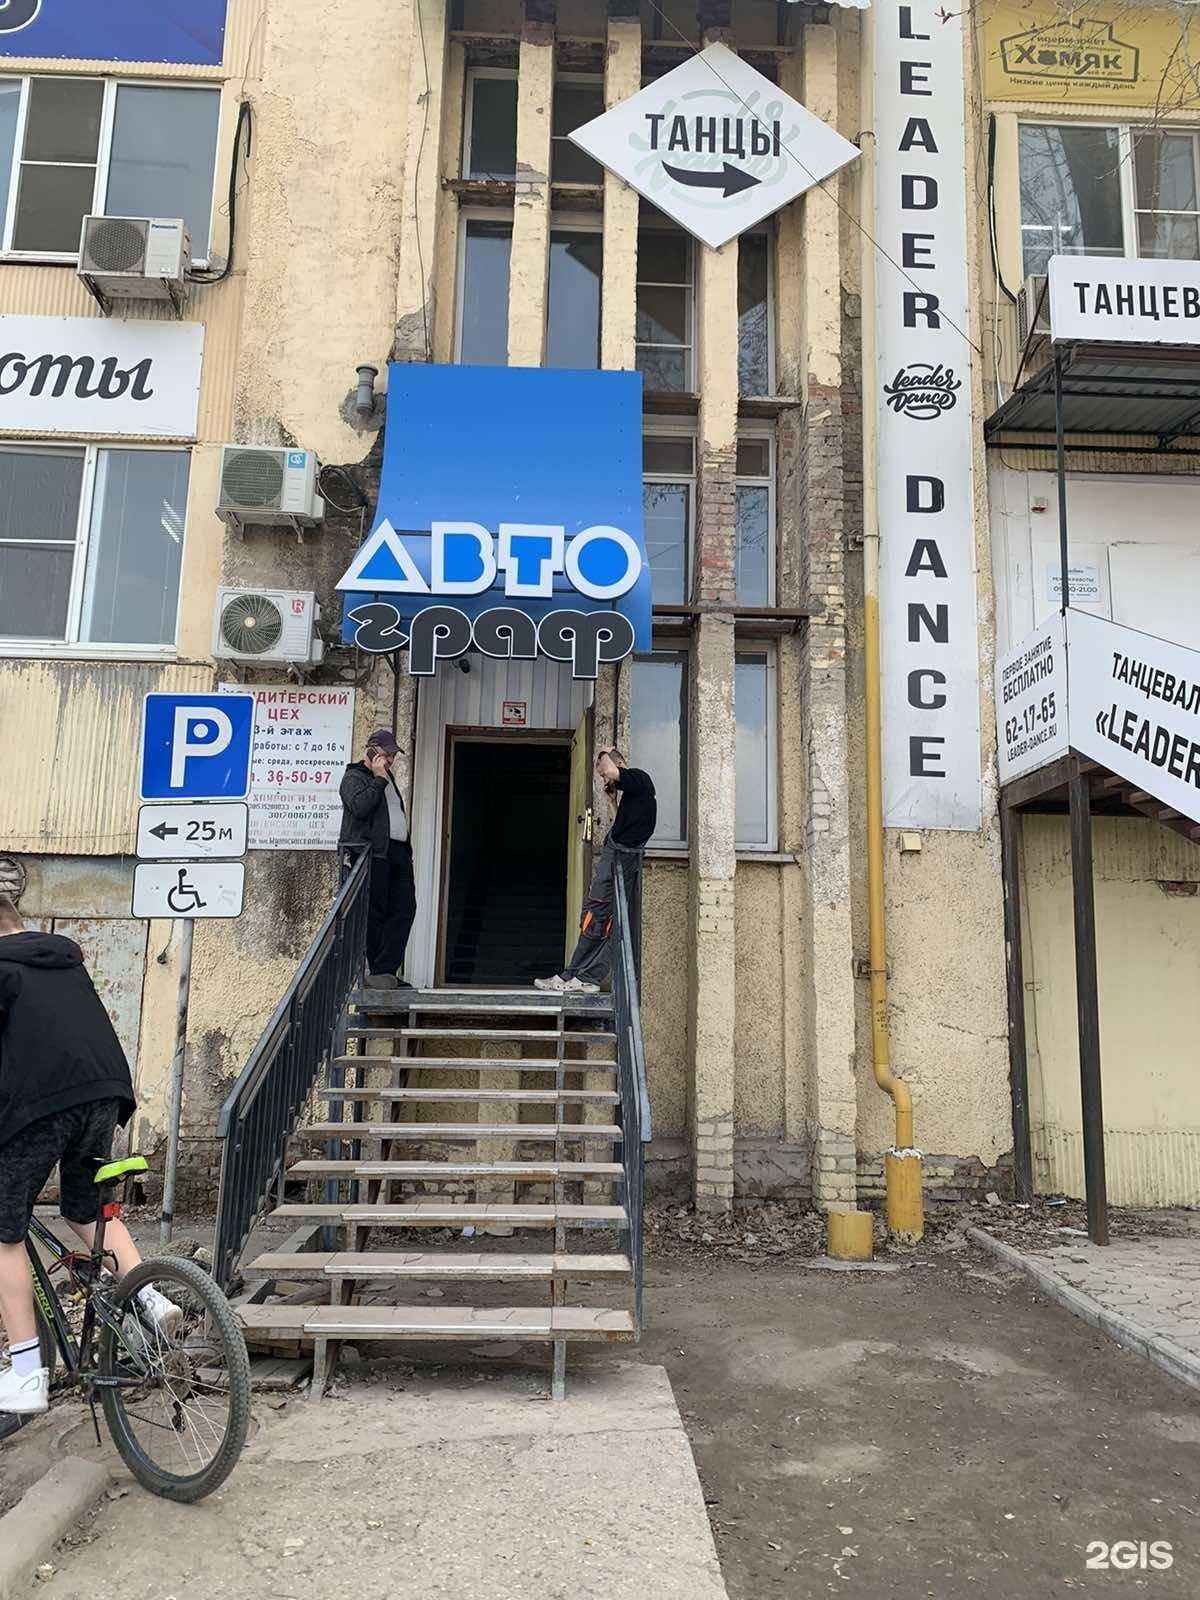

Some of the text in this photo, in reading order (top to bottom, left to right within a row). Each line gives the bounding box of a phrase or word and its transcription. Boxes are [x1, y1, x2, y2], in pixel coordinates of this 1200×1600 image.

[645, 113, 780, 159] ТАНЦЫ
[898, 6, 941, 330] LEADER
[1073, 282, 1200, 321] ТАНЦЕВ
[334, 518, 642, 600] АВТО
[347, 602, 636, 679] граф
[904, 474, 950, 778] DANCE
[1024, 635, 1052, 667] ЗАНЯТИЕ
[1003, 654, 1054, 704] БЕСПЛАТНО
[1112, 652, 1200, 715] ТАНЦЕВАЛ
[268, 708, 300, 721] ЦЕХ
[280, 728, 313, 736] этаж
[1005, 691, 1056, 745] 62-17-65
[303, 742, 309, 750] 7
[311, 744, 323, 752] до
[327, 743, 337, 751] 16
[1007, 723, 1057, 762] LEADER-DANCE.RU
[267, 770, 332, 784] 36-50-97
